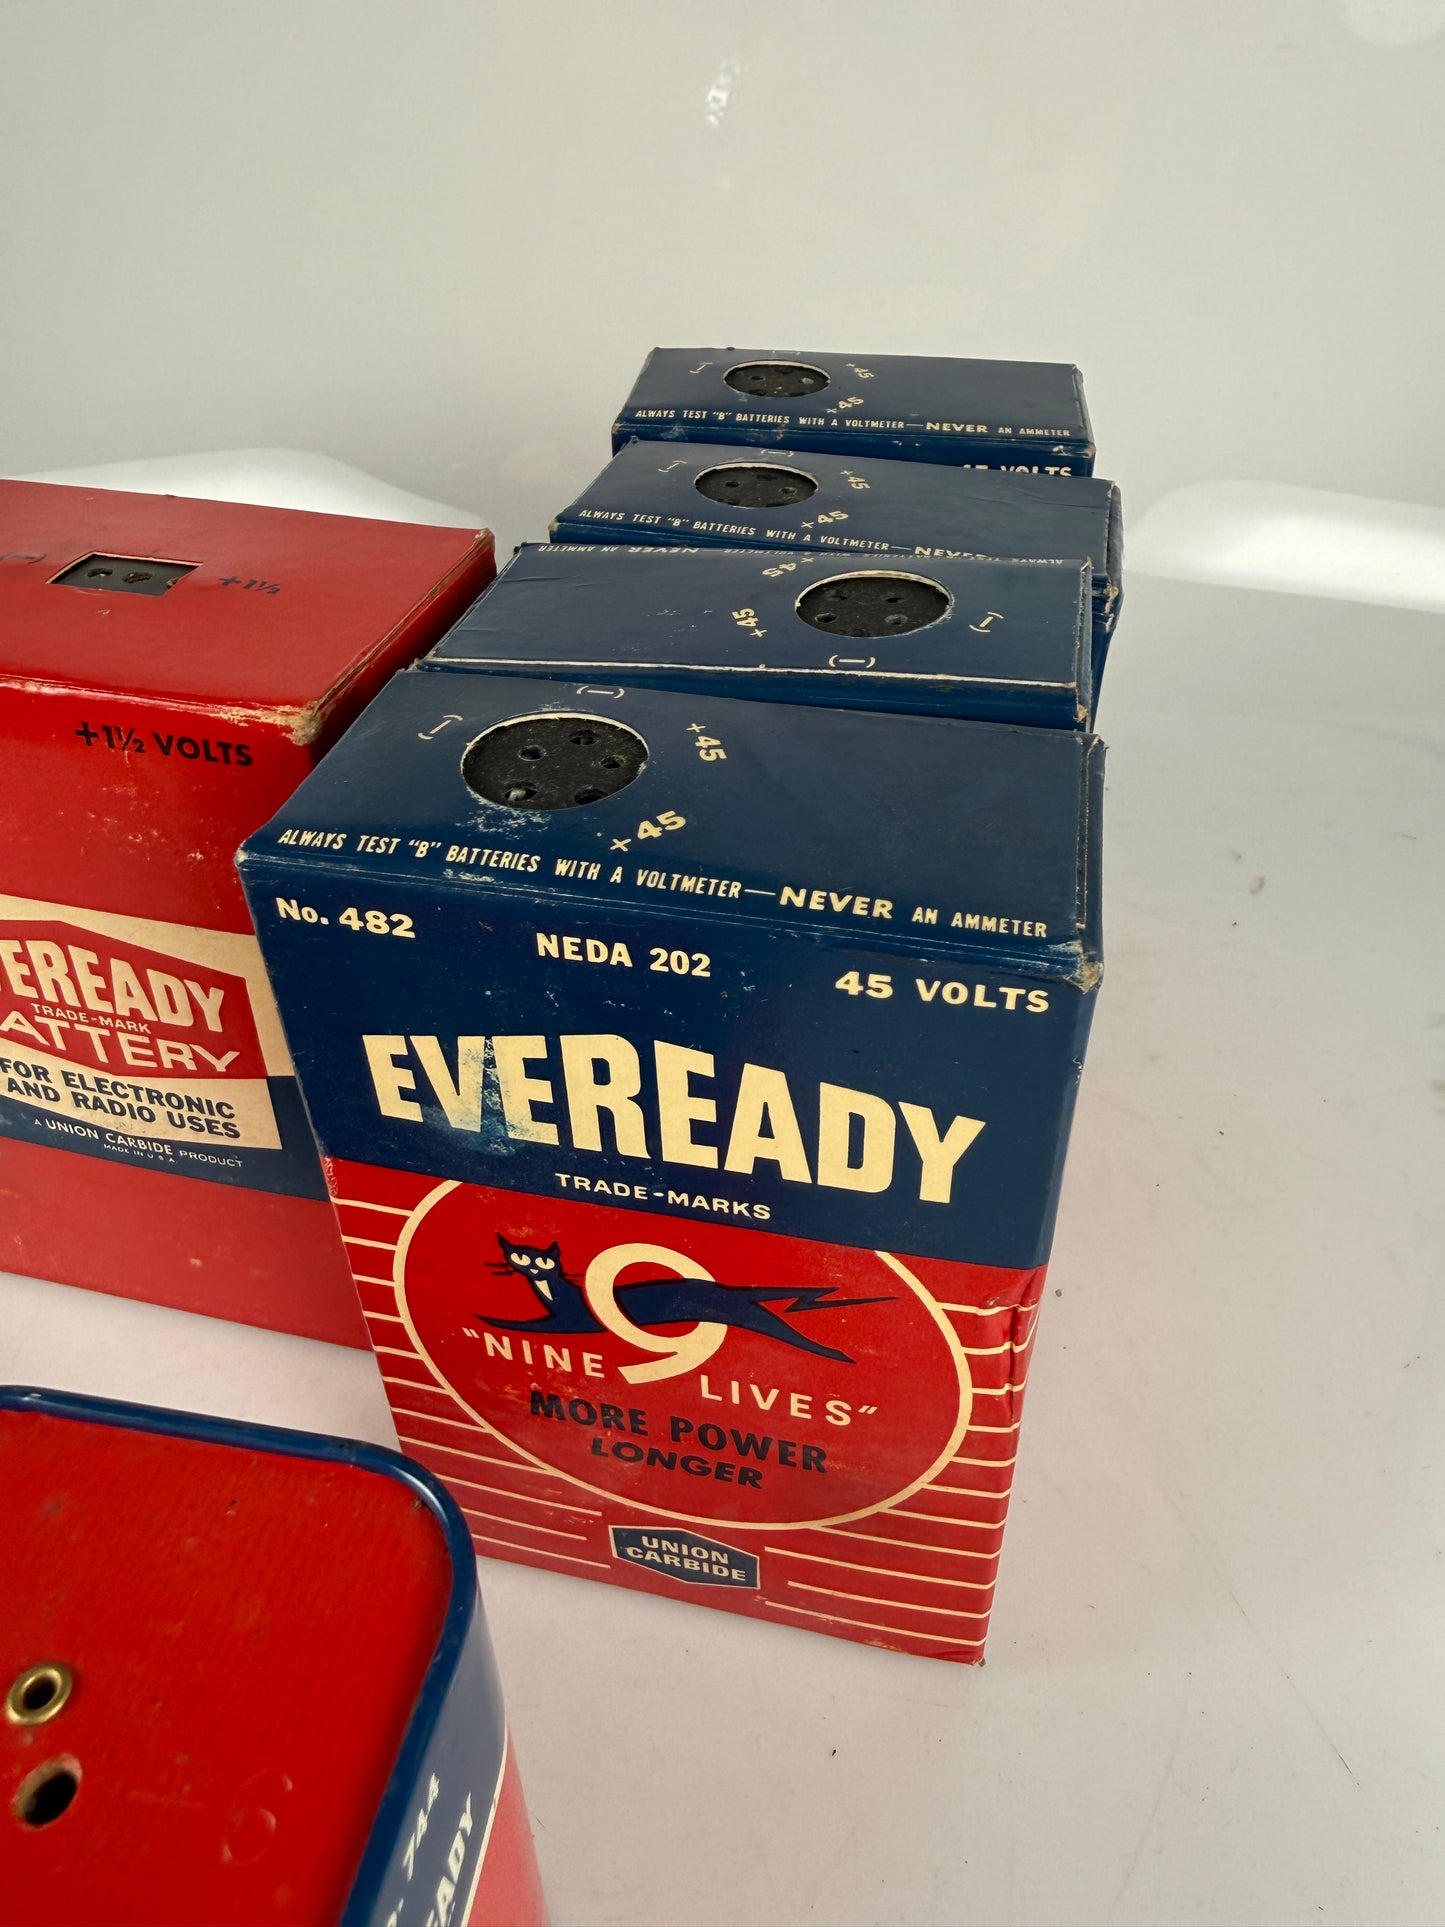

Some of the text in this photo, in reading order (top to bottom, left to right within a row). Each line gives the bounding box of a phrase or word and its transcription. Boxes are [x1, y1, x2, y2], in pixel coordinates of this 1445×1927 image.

[636, 409, 676, 418] ALWAYS
[683, 410, 707, 419] TEST
[736, 413, 790, 424] BATTERIES
[799, 416, 825, 426] WITH
[831, 418, 838, 426] A
[998, 426, 1012, 434] AN
[1018, 428, 1071, 437] AMMETER
[579, 509, 625, 521] ALWAYS
[633, 513, 662, 524] TEST
[693, 521, 756, 536] BATTERIES
[766, 529, 797, 540] WITH
[803, 533, 811, 542] A
[151, 731, 253, 767] VOLTS
[278, 829, 346, 851] ALWAYS
[356, 835, 401, 855] TEST
[408, 839, 442, 859] "B"
[445, 845, 541, 873] BATTERIES
[555, 858, 602, 881] WITH
[610, 866, 623, 884] A
[912, 906, 938, 925] AN
[950, 911, 1047, 938] AMMETER
[275, 896, 416, 939] No. 482
[536, 932, 711, 979] NEDA 202
[835, 970, 1049, 1013] 45 VOLTS
[30, 1002, 152, 1035] TRADE-MARK
[0, 1057, 236, 1120] FOR ELECTRONIC
[7, 1077, 241, 1139] AND RADIO USES
[34, 1117, 244, 1168] A UNION CARBIDE PRODUCT
[362, 1034, 986, 1204] EVEREADY
[103, 1143, 130, 1154] MADE
[554, 1172, 772, 1221] TRADE-MARKS
[585, 1242, 728, 1384] 9
[530, 1390, 828, 1473] MORE POWER
[591, 1437, 763, 1490] LONGER
[626, 1546, 746, 1582] CARBIDE
[641, 1535, 729, 1565] UNION
